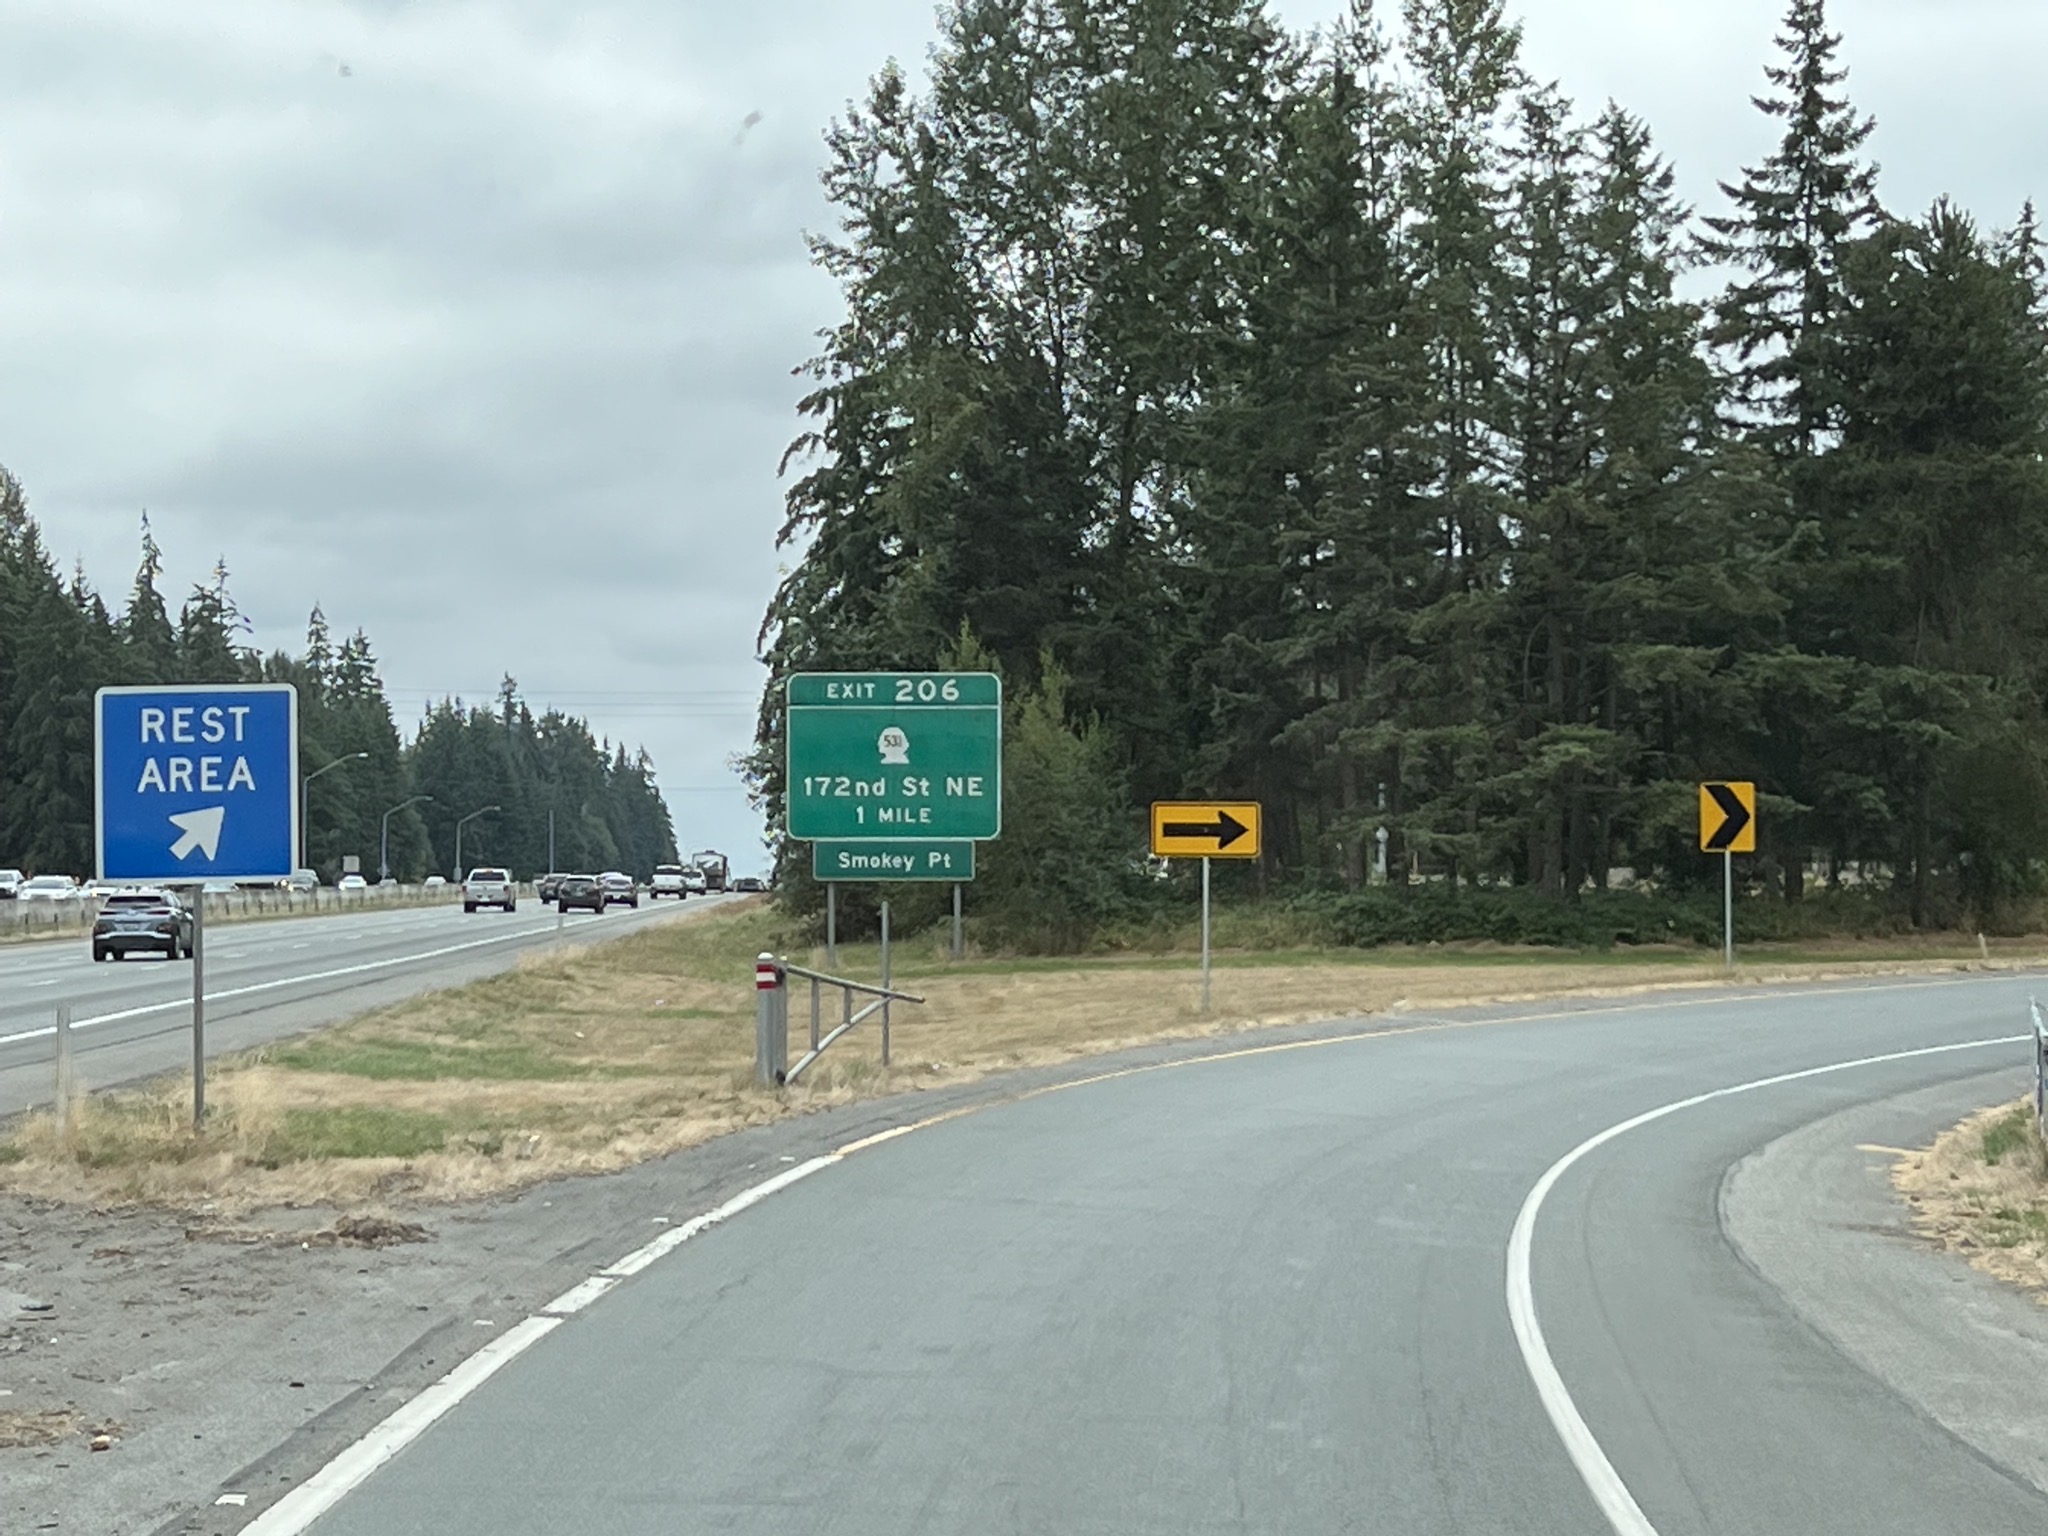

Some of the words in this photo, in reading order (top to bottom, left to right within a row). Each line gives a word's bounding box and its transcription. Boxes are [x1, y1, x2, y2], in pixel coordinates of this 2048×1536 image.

[827, 683, 876, 699] EXIT
[895, 679, 960, 702] 206
[141, 706, 250, 743] REST
[137, 756, 256, 793] AREA
[804, 776, 886, 797] 172nd
[902, 777, 930, 797] St
[946, 777, 984, 797] NE
[856, 806, 865, 824] 1
[878, 807, 932, 824] MILE
[838, 851, 915, 872] Smokey
[929, 852, 951, 868] Pt
